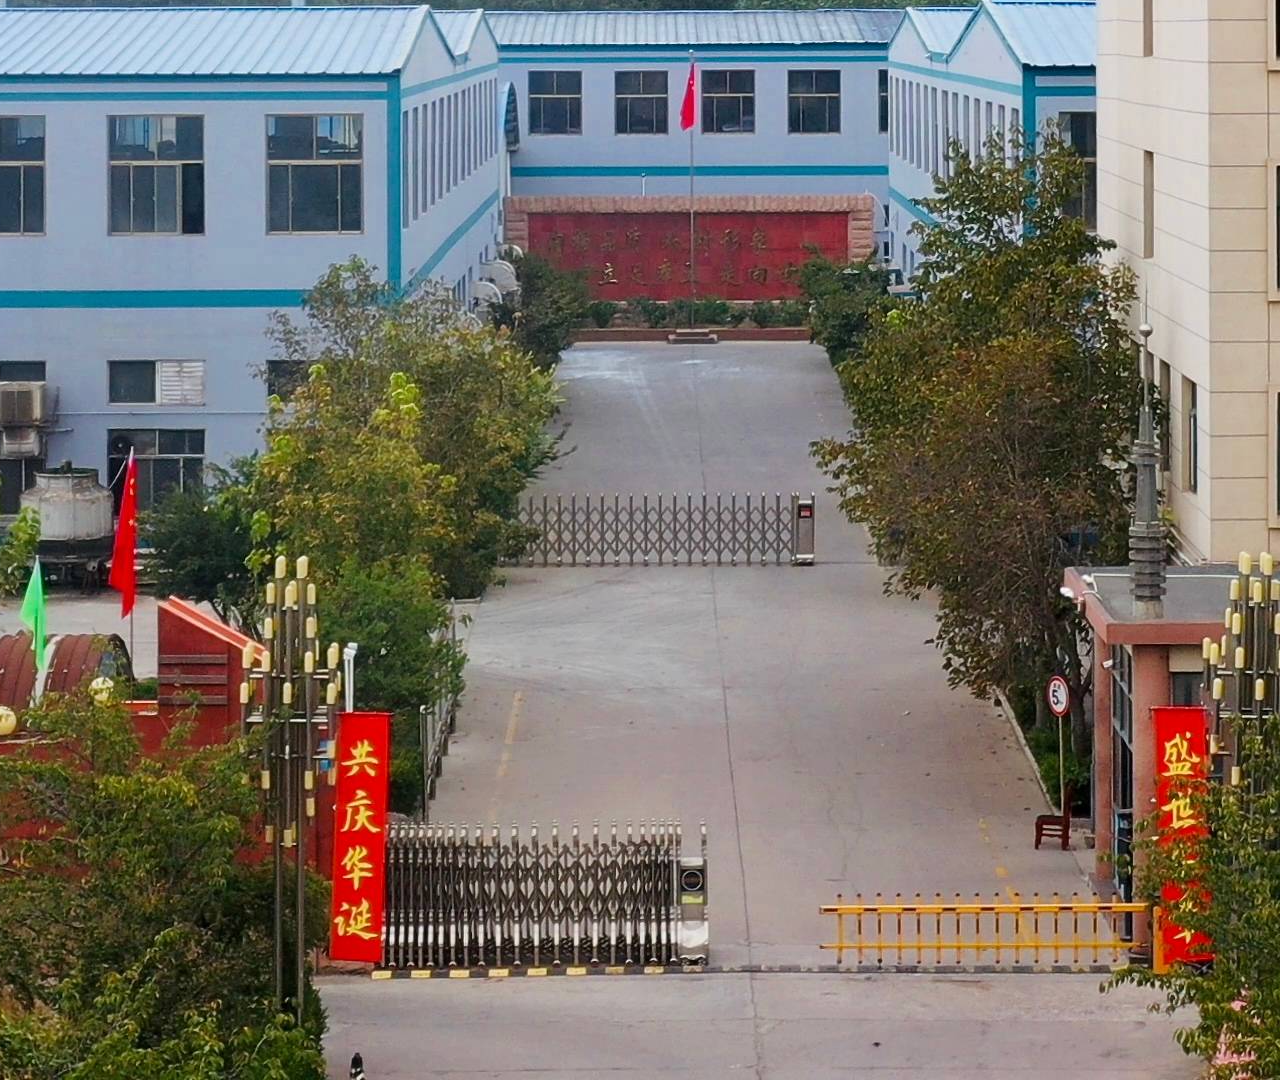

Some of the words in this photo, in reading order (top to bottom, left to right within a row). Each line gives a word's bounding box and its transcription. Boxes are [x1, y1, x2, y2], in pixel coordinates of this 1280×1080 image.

[1052, 689, 1060, 706] 5
[334, 739, 382, 941] 共庆华诞
